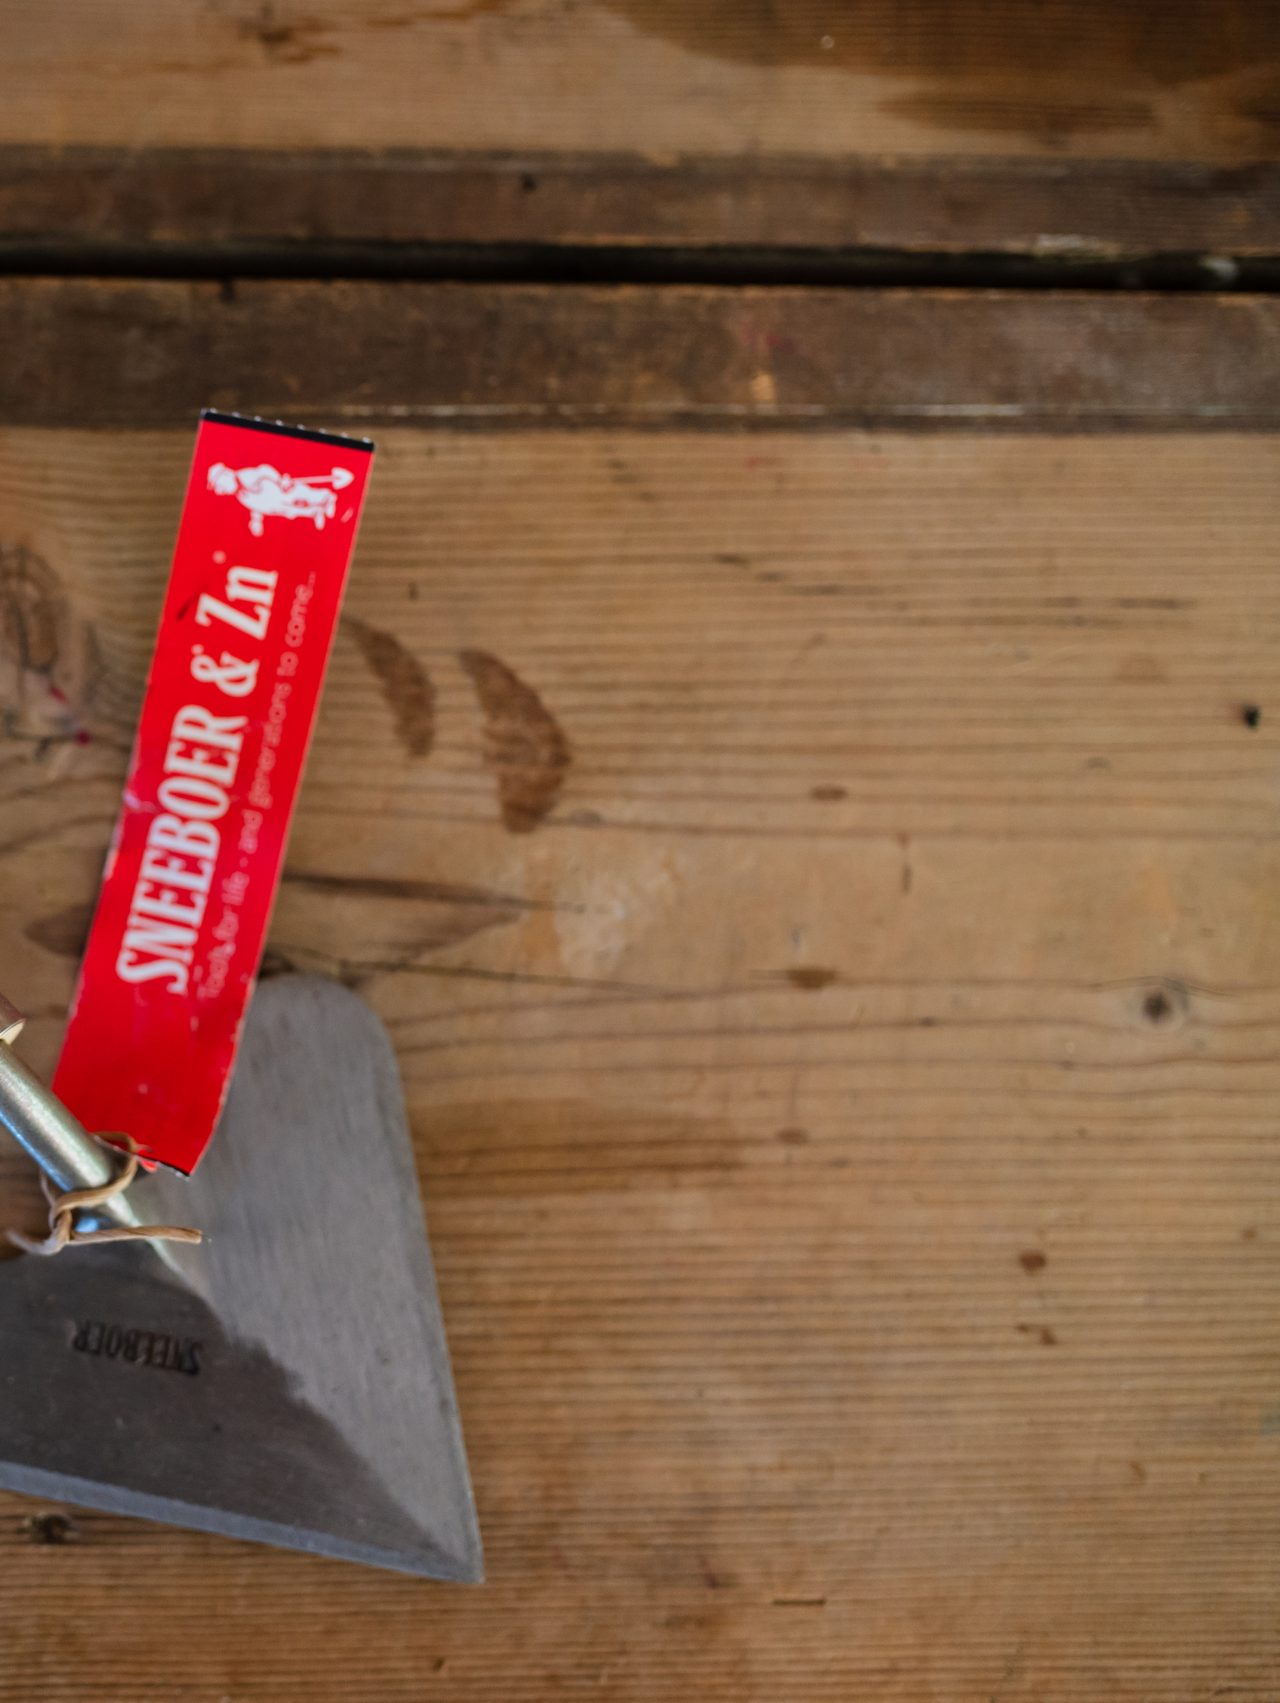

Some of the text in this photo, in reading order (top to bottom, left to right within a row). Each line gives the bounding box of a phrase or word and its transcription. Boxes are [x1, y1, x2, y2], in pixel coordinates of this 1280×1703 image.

[276, 652, 298, 676] to
[248, 682, 293, 809] generations
[116, 566, 278, 997] SNEEBOER & Zn
[238, 809, 263, 854] and
[221, 871, 249, 906] life
[212, 905, 239, 942] for
